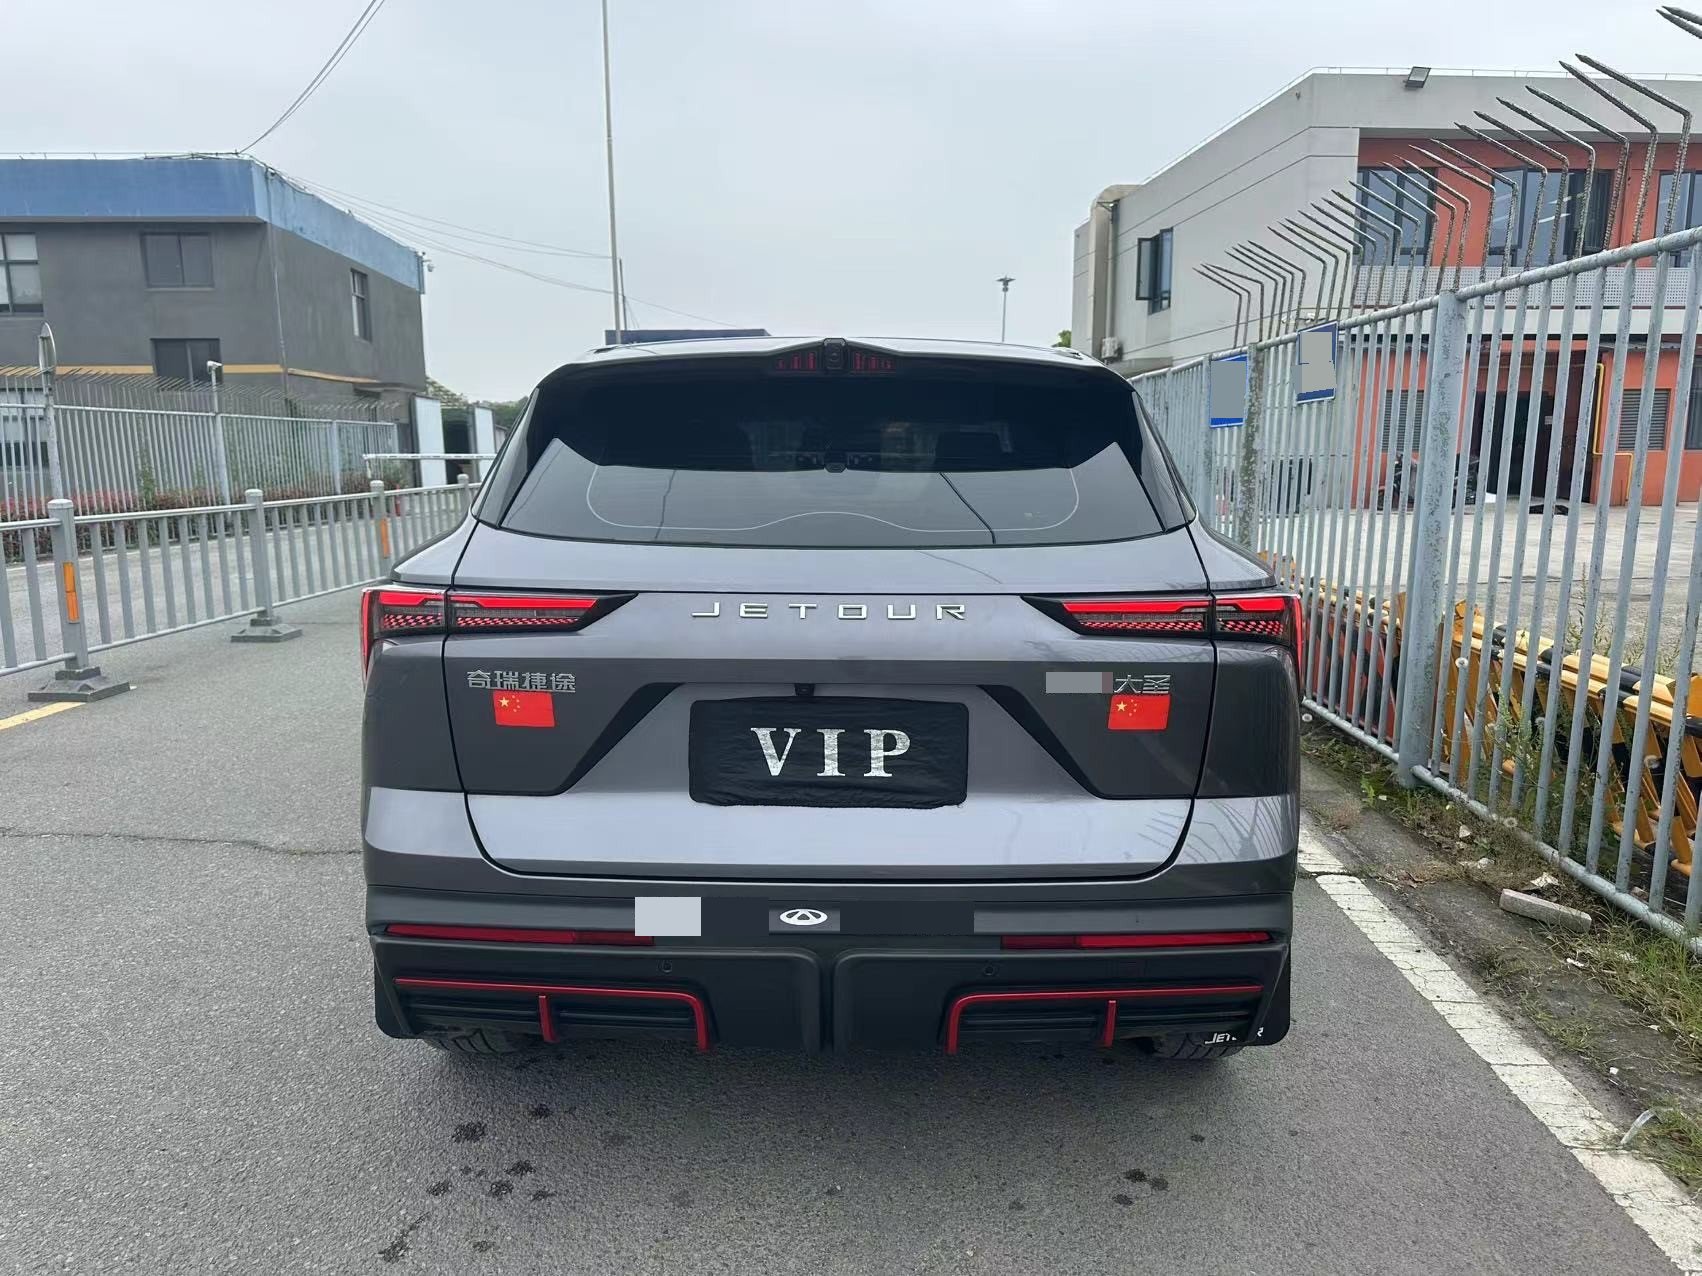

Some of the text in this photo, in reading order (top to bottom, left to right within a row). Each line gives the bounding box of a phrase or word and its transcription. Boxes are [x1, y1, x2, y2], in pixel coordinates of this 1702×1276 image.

[691, 601, 966, 621] JETOUR
[466, 669, 576, 693] 奇瑞捷途
[750, 727, 911, 777] VIP
